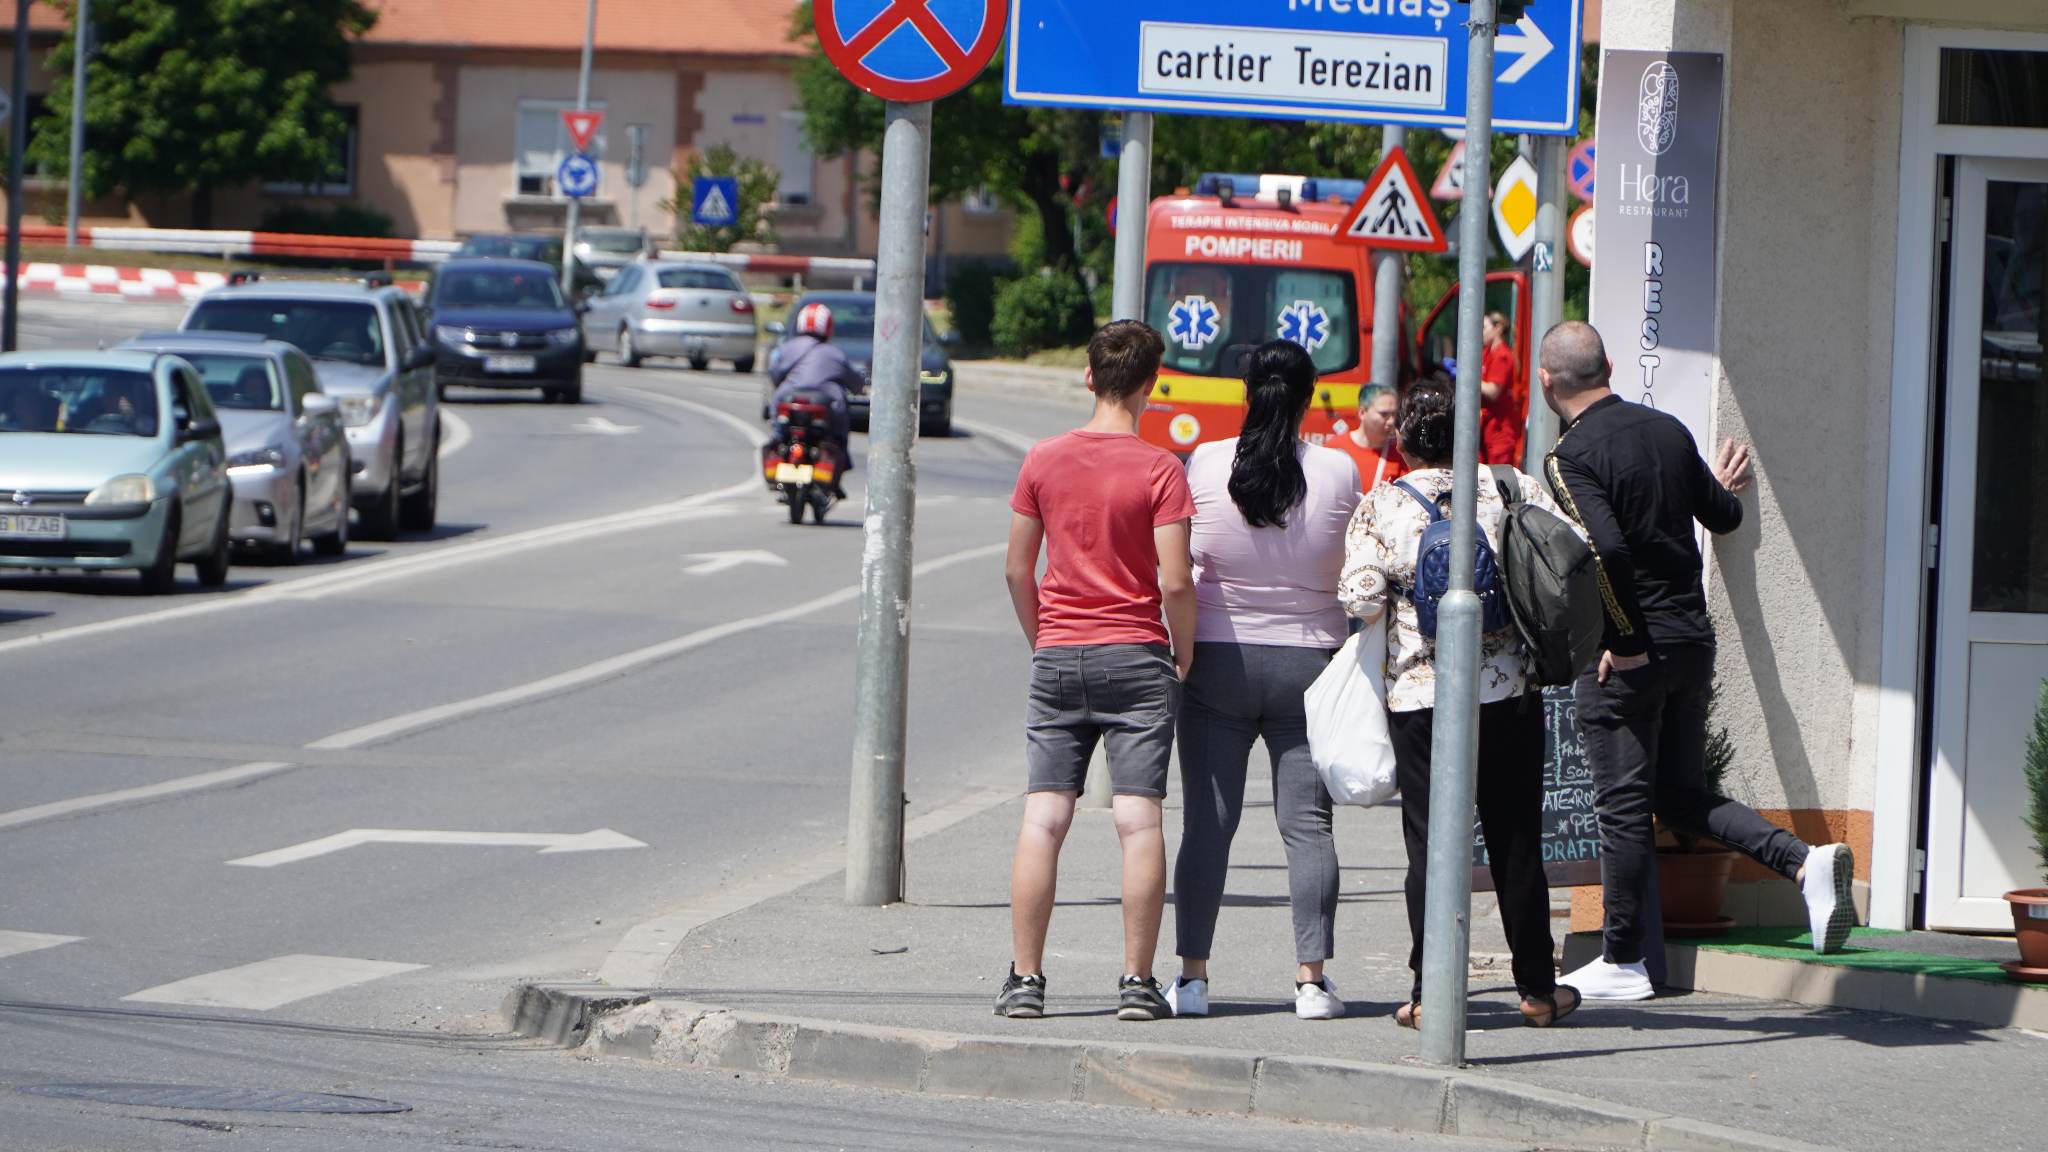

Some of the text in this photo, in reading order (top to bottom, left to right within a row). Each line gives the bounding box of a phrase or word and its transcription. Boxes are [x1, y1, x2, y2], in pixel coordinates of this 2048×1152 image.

[1157, 43, 1433, 92] cartier Terezian
[1620, 163, 1689, 204] Hera
[1171, 215, 1224, 229] TERAPIE
[1225, 216, 1290, 232] INTENSIVA
[1619, 205, 1689, 218] RESTAURANT
[1185, 235, 1303, 260] POMPIERII
[1542, 838, 1601, 861] DRAFT
